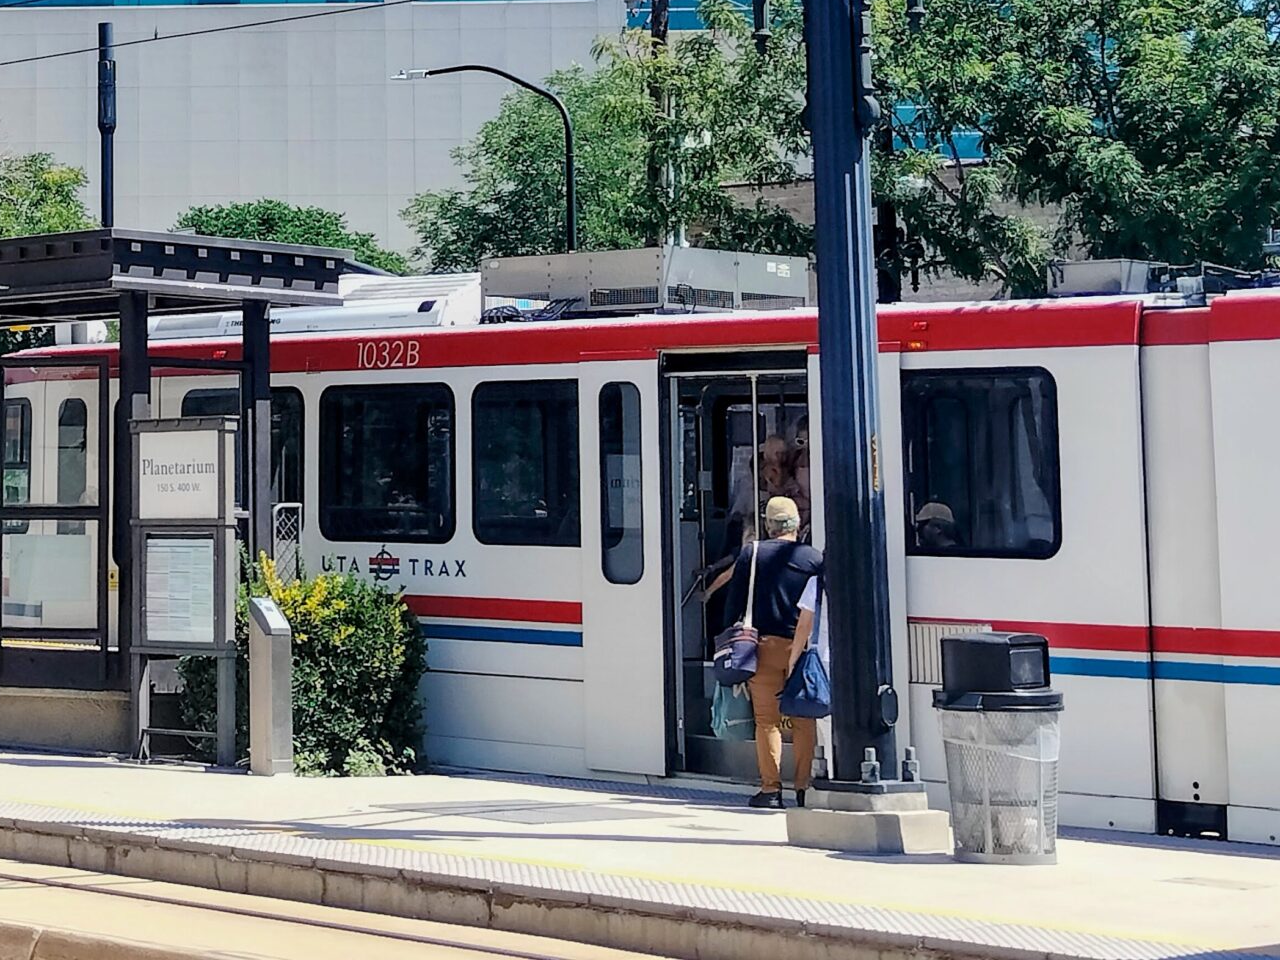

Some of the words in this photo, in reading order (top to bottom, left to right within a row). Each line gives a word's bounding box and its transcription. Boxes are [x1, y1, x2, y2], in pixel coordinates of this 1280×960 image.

[357, 341, 420, 368] 1032B
[142, 458, 215, 476] Planetarium
[157, 483, 169, 493] 150
[177, 482, 191, 492] 400
[321, 555, 360, 573] UTA
[408, 558, 466, 577] TRAX
